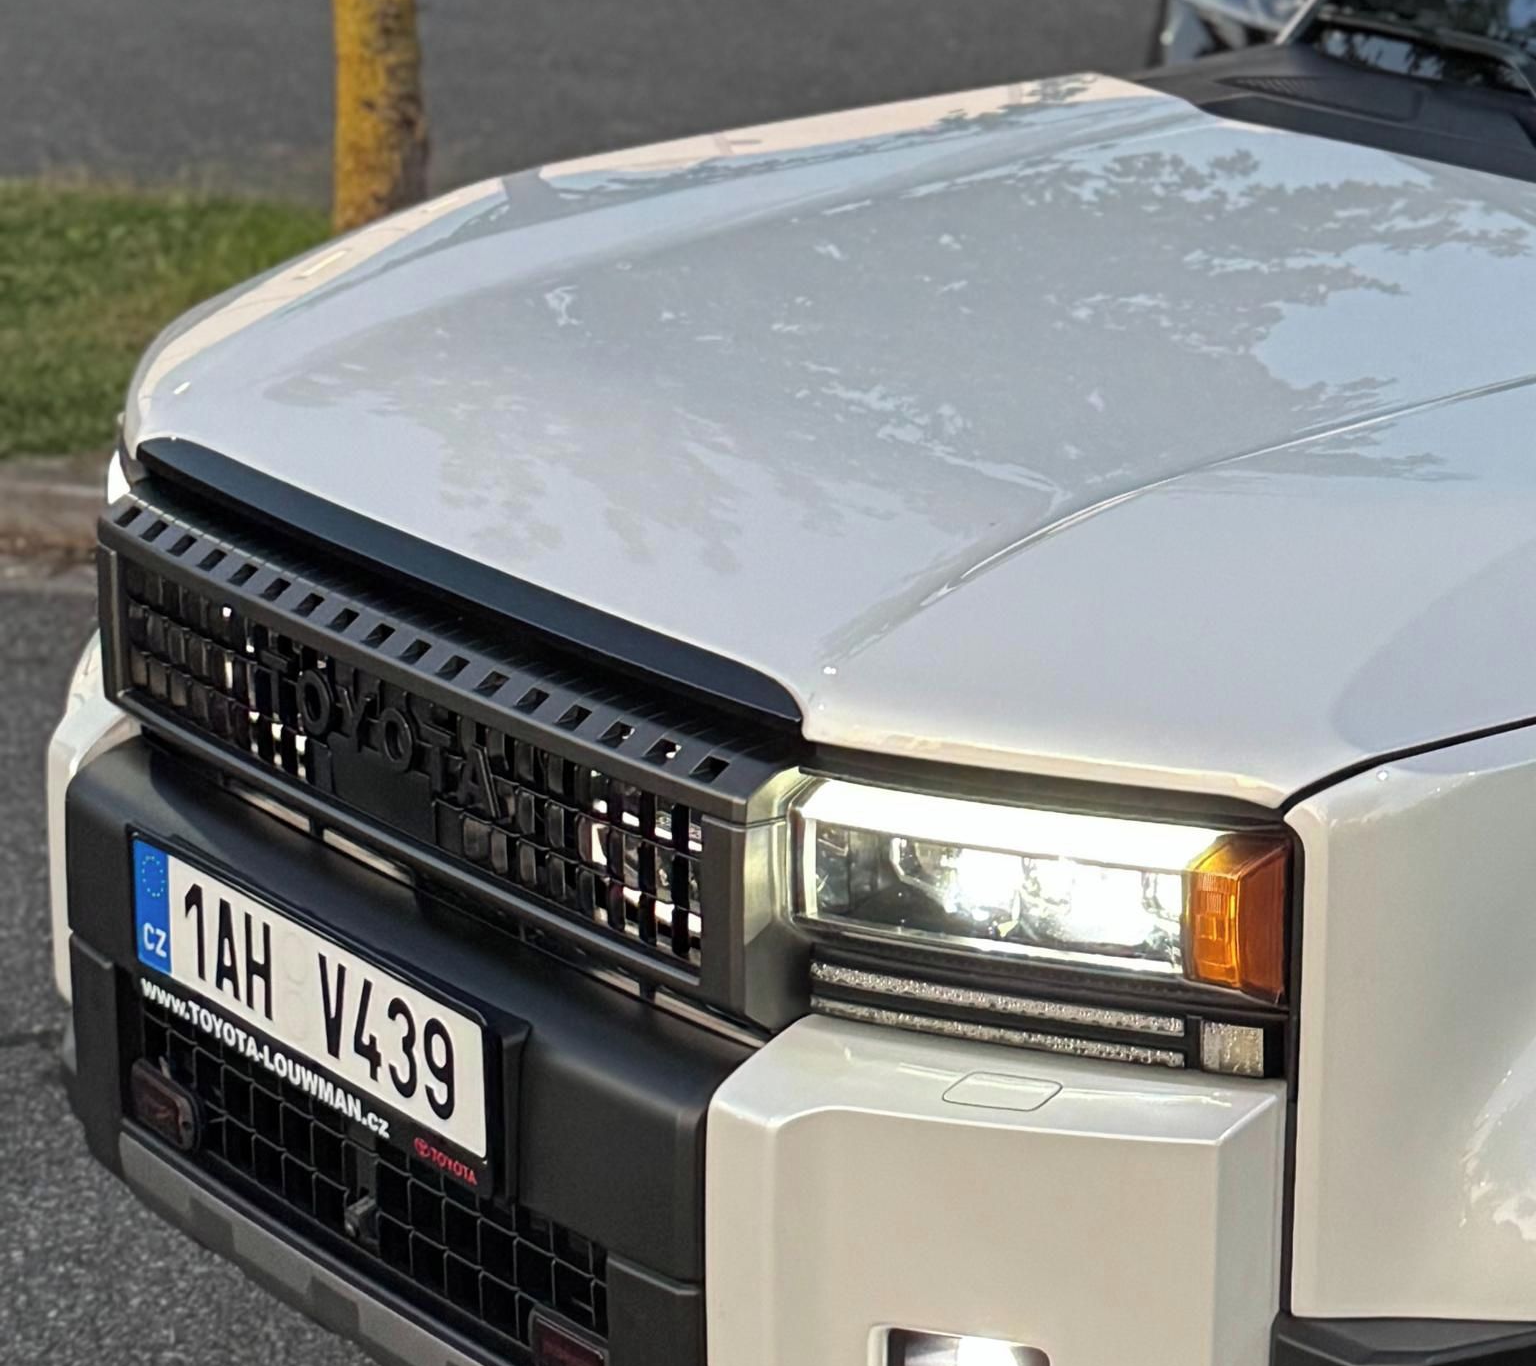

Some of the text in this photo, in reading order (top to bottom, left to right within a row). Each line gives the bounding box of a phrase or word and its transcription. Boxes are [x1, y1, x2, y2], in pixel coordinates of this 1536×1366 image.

[261, 646, 504, 820] TOYOTA
[143, 923, 167, 958] CZ
[184, 884, 455, 1120] 1AH V439
[142, 979, 390, 1138] www.TOYOTA-LOUWMAN.cz
[430, 1151, 477, 1185] TOYOTA
